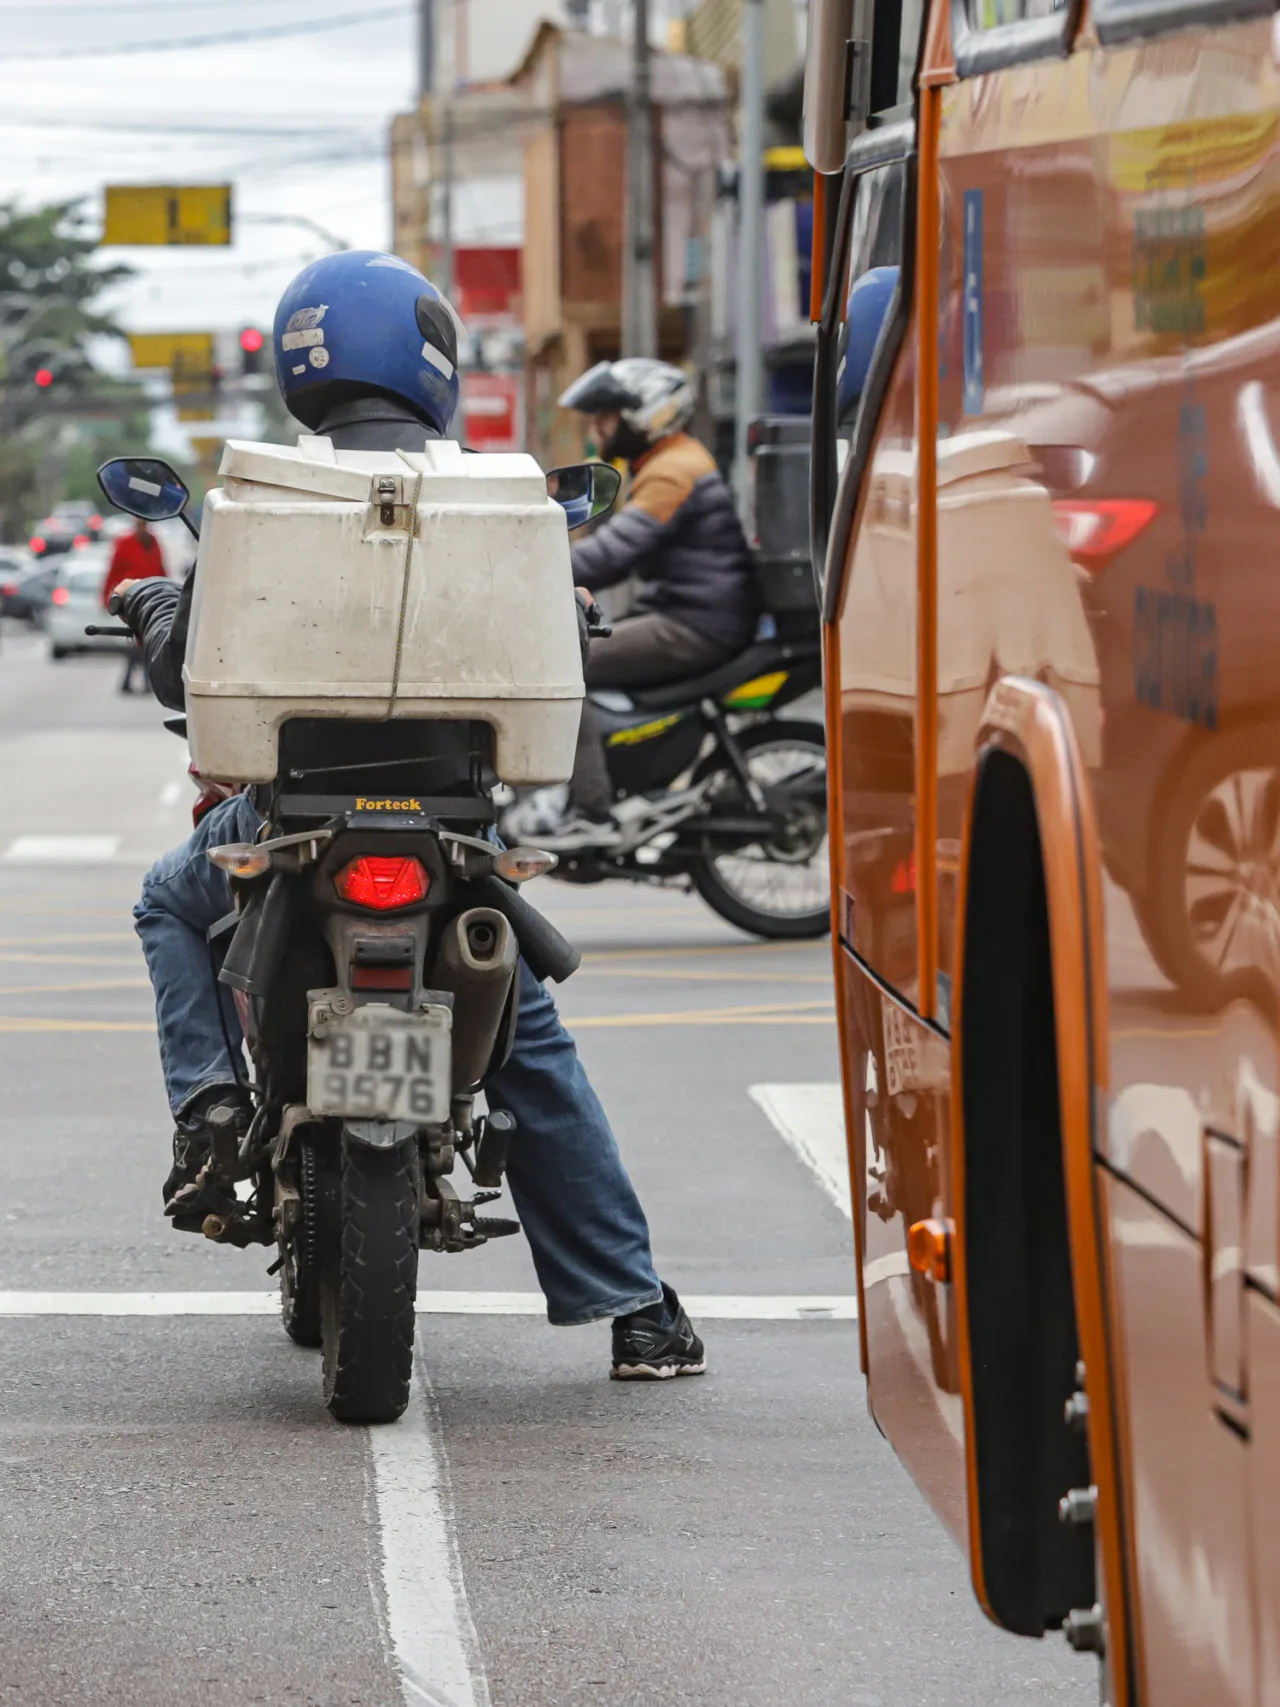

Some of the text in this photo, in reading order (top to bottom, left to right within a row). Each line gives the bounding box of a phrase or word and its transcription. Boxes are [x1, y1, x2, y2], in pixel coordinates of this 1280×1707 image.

[355, 797, 422, 811] Forteck
[329, 1032, 432, 1074] BBN
[324, 1073, 435, 1116] 9576
